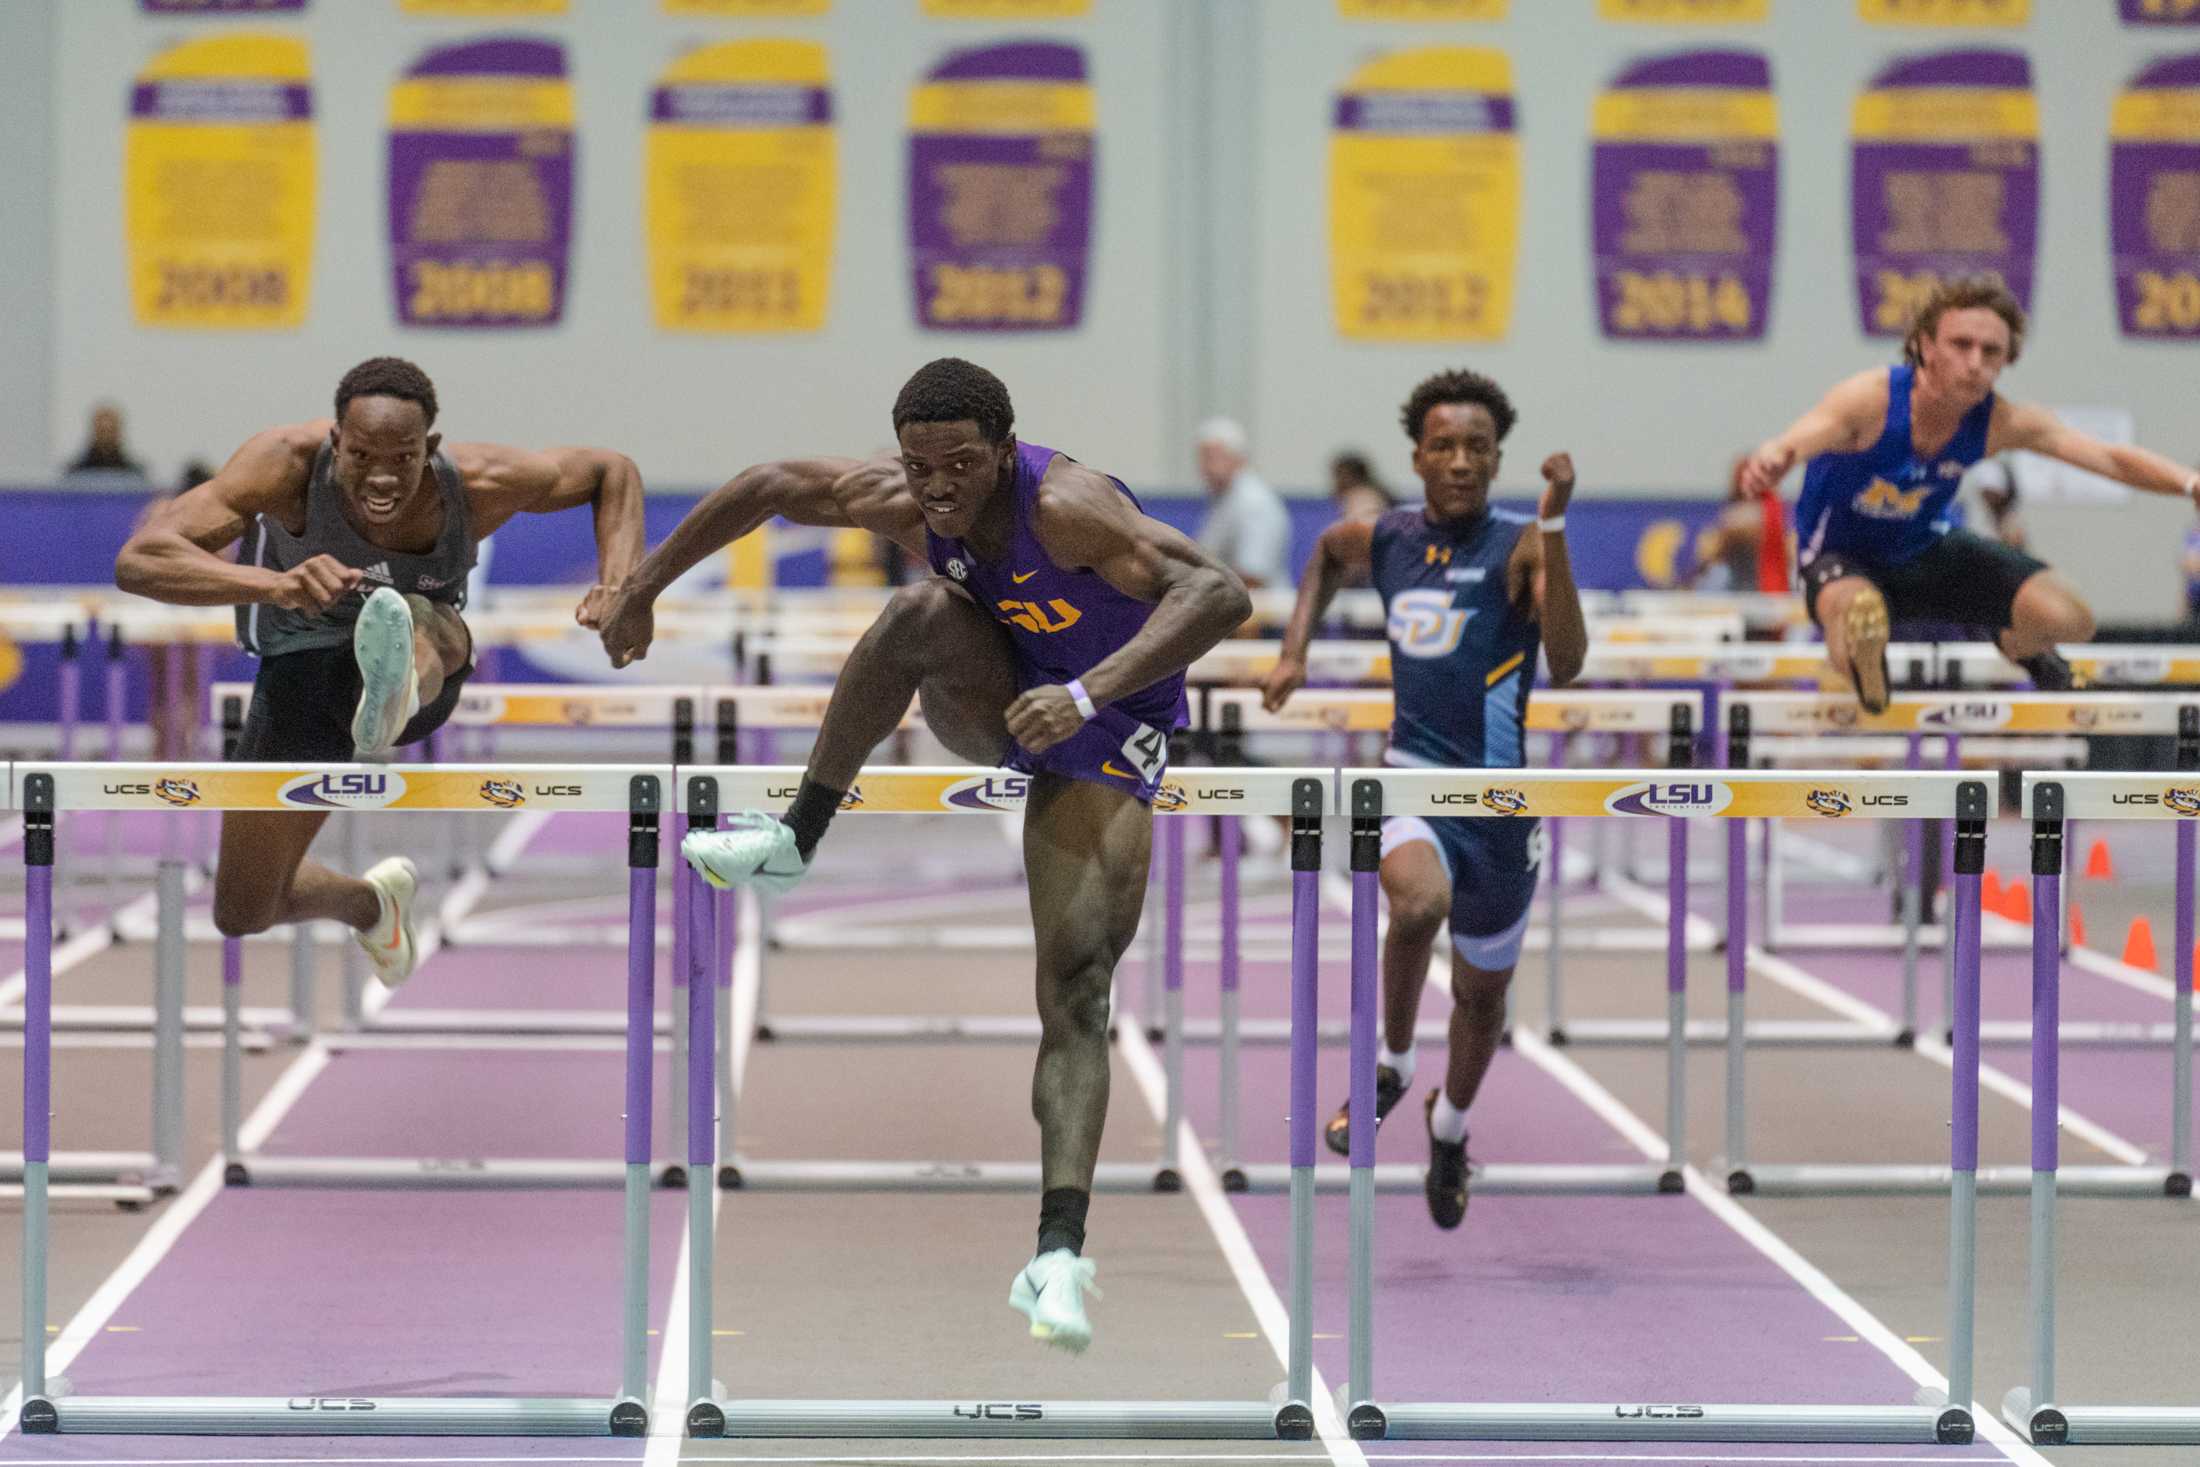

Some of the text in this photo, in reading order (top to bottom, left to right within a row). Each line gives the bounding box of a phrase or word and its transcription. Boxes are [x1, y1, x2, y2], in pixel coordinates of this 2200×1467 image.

[1612, 269, 1751, 328] 2014
[998, 598, 1084, 634] SU
[1133, 729, 1160, 769] 4
[104, 784, 150, 795] UCS
[322, 774, 386, 794] LSU
[535, 785, 582, 796] UCS
[985, 777, 1026, 798] LS
[767, 787, 798, 798] UC
[1198, 789, 1245, 800] UCS
[1431, 793, 1478, 804] UCS
[1649, 783, 1713, 804] LSU
[2112, 794, 2159, 804] UCS
[1862, 795, 1909, 806] UCS
[288, 1398, 377, 1411] UCS
[953, 1403, 1043, 1419] UCS
[1615, 1404, 1704, 1418] UCS
[2033, 1422, 2065, 1432] UCS
